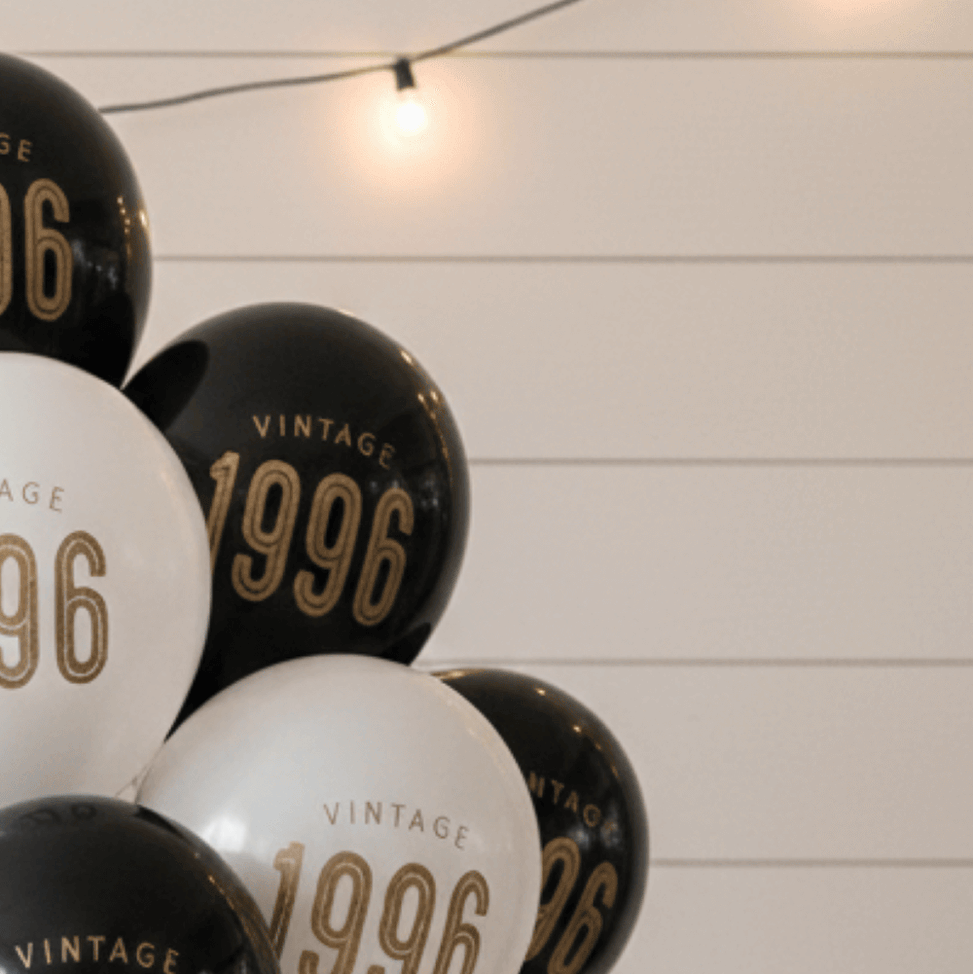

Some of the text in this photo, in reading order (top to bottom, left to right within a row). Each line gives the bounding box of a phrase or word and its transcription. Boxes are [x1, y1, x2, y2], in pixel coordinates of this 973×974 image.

[253, 414, 397, 470] VINTAGE
[208, 451, 414, 627] 1996
[323, 800, 470, 850] VINTAGE
